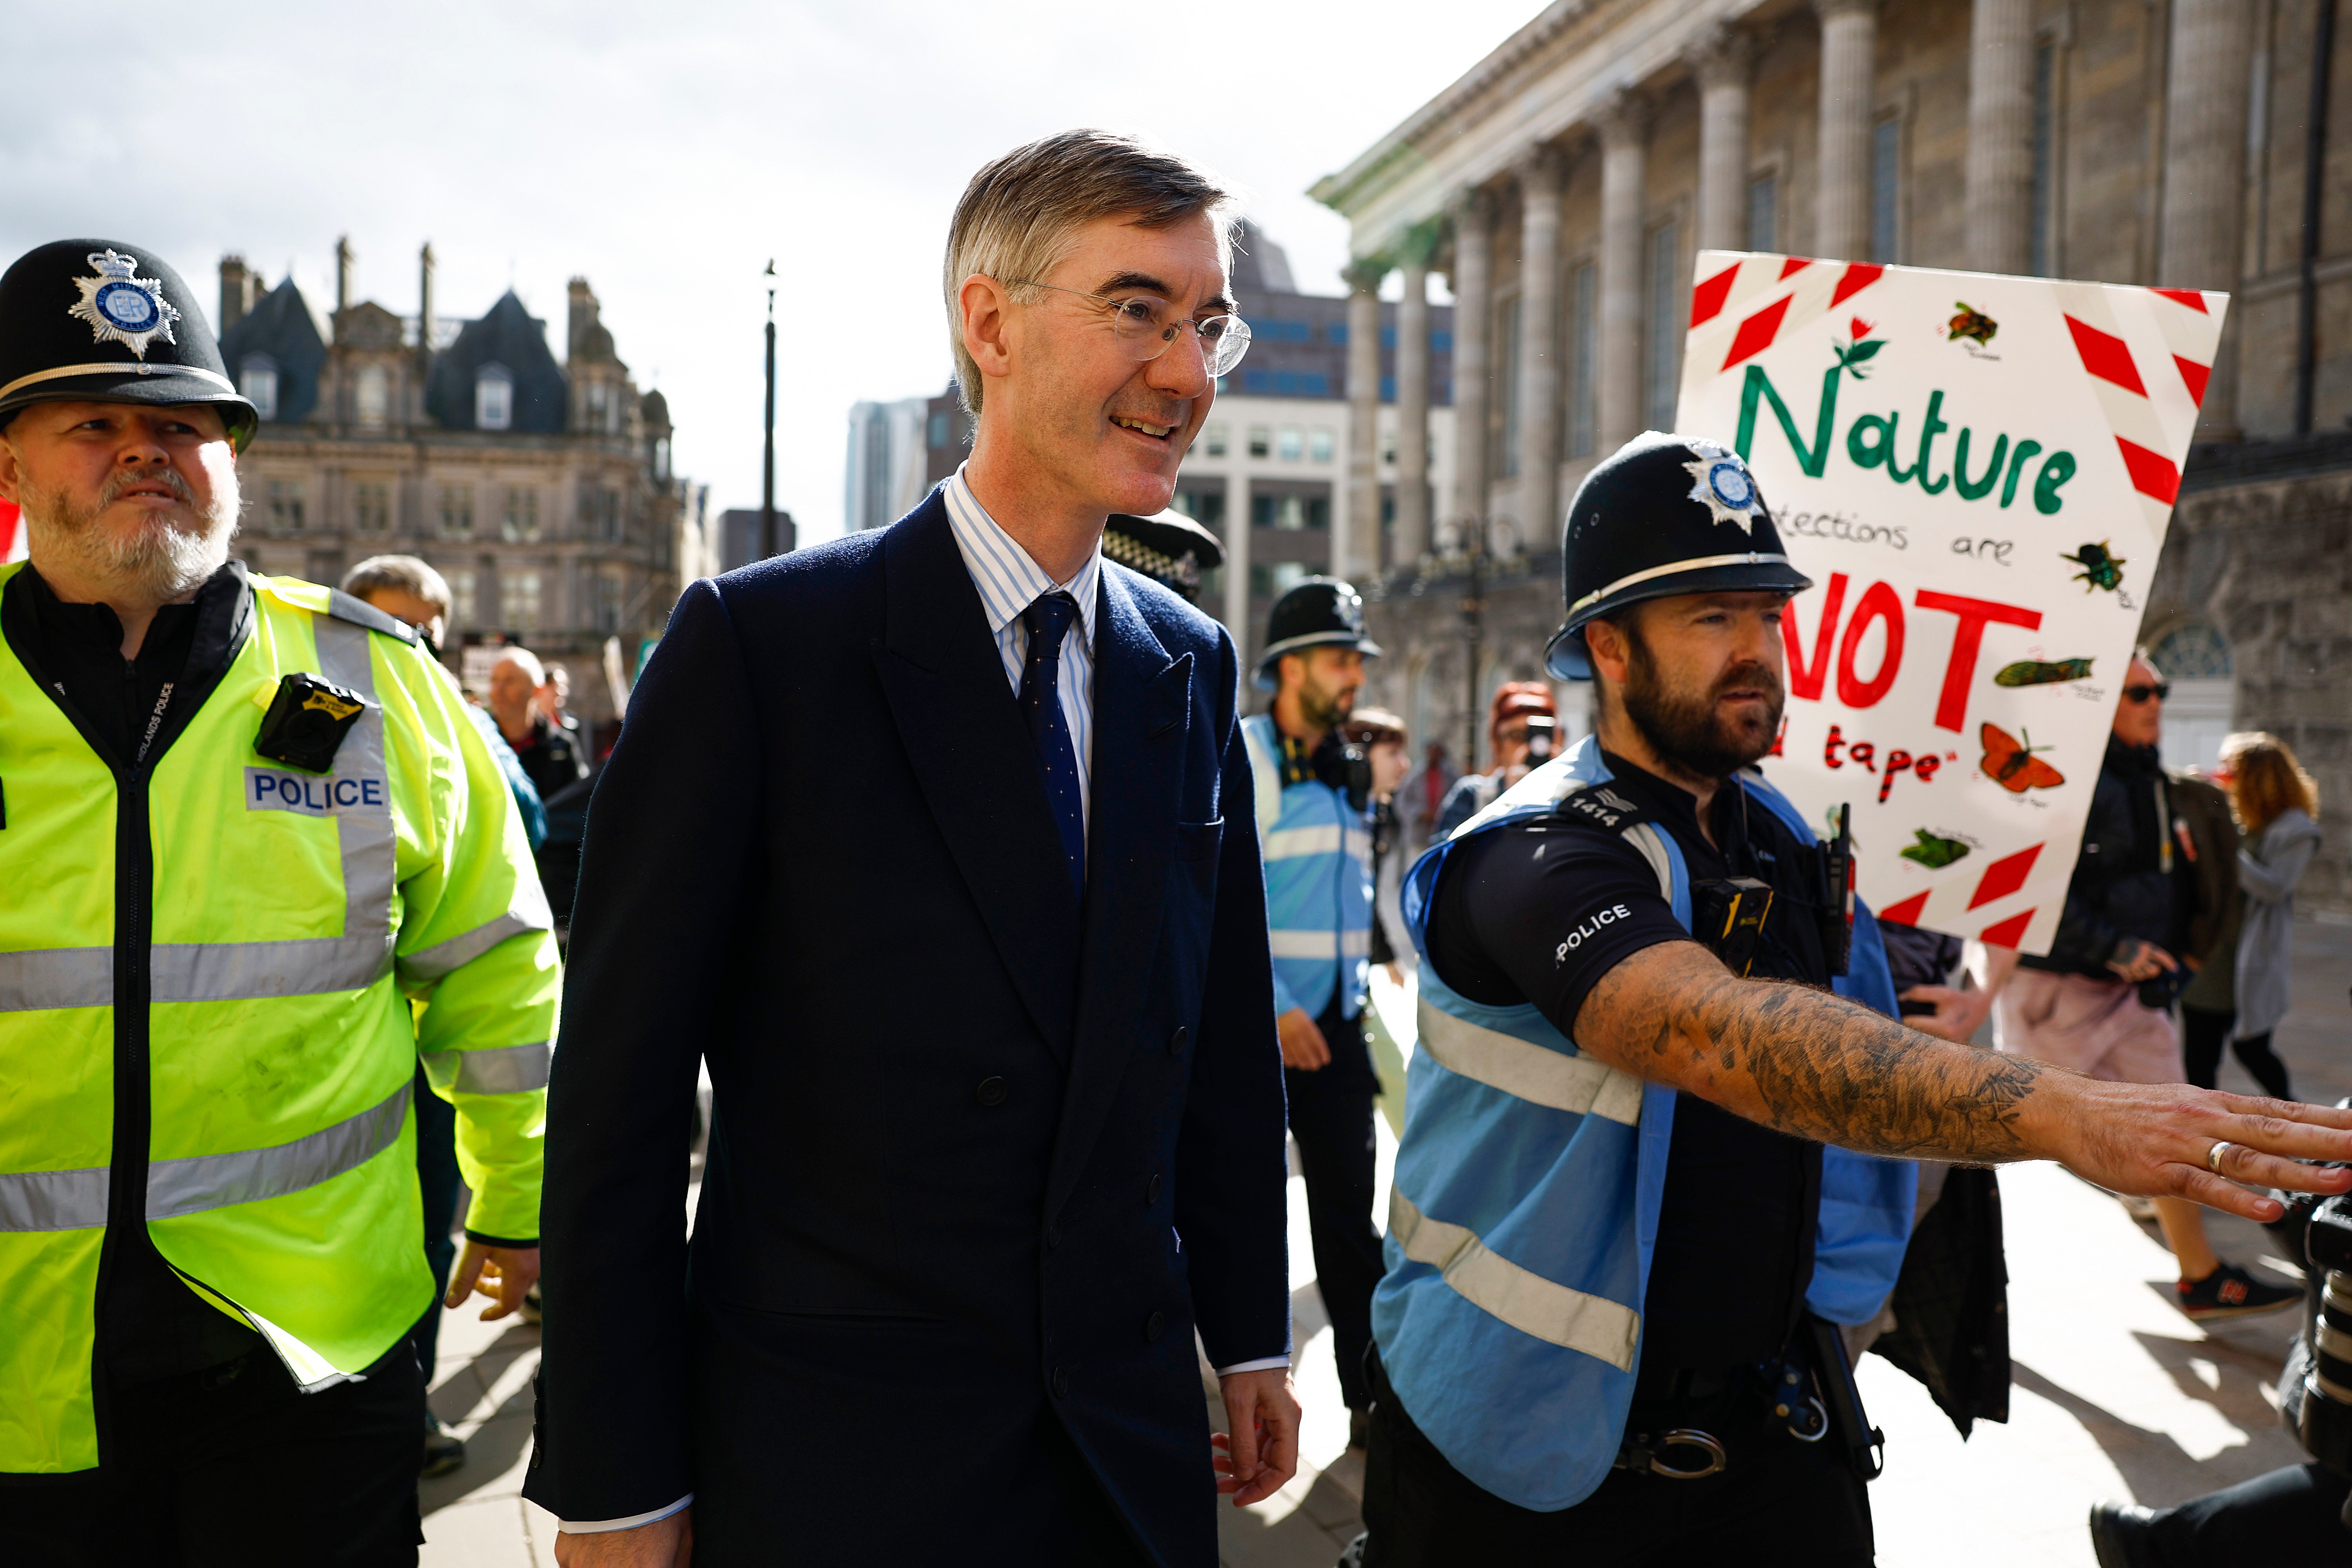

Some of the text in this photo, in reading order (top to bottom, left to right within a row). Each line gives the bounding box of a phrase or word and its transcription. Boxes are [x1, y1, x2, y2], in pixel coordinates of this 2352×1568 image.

[1735, 365, 2076, 514] Nature
[1769, 501, 2013, 566] tections are
[1781, 572, 2044, 734] NOT
[154, 682, 174, 716] POLICE
[255, 775, 383, 809] POLICE
[1572, 797, 1620, 827] 1414
[1556, 904, 1632, 962] POLICE
